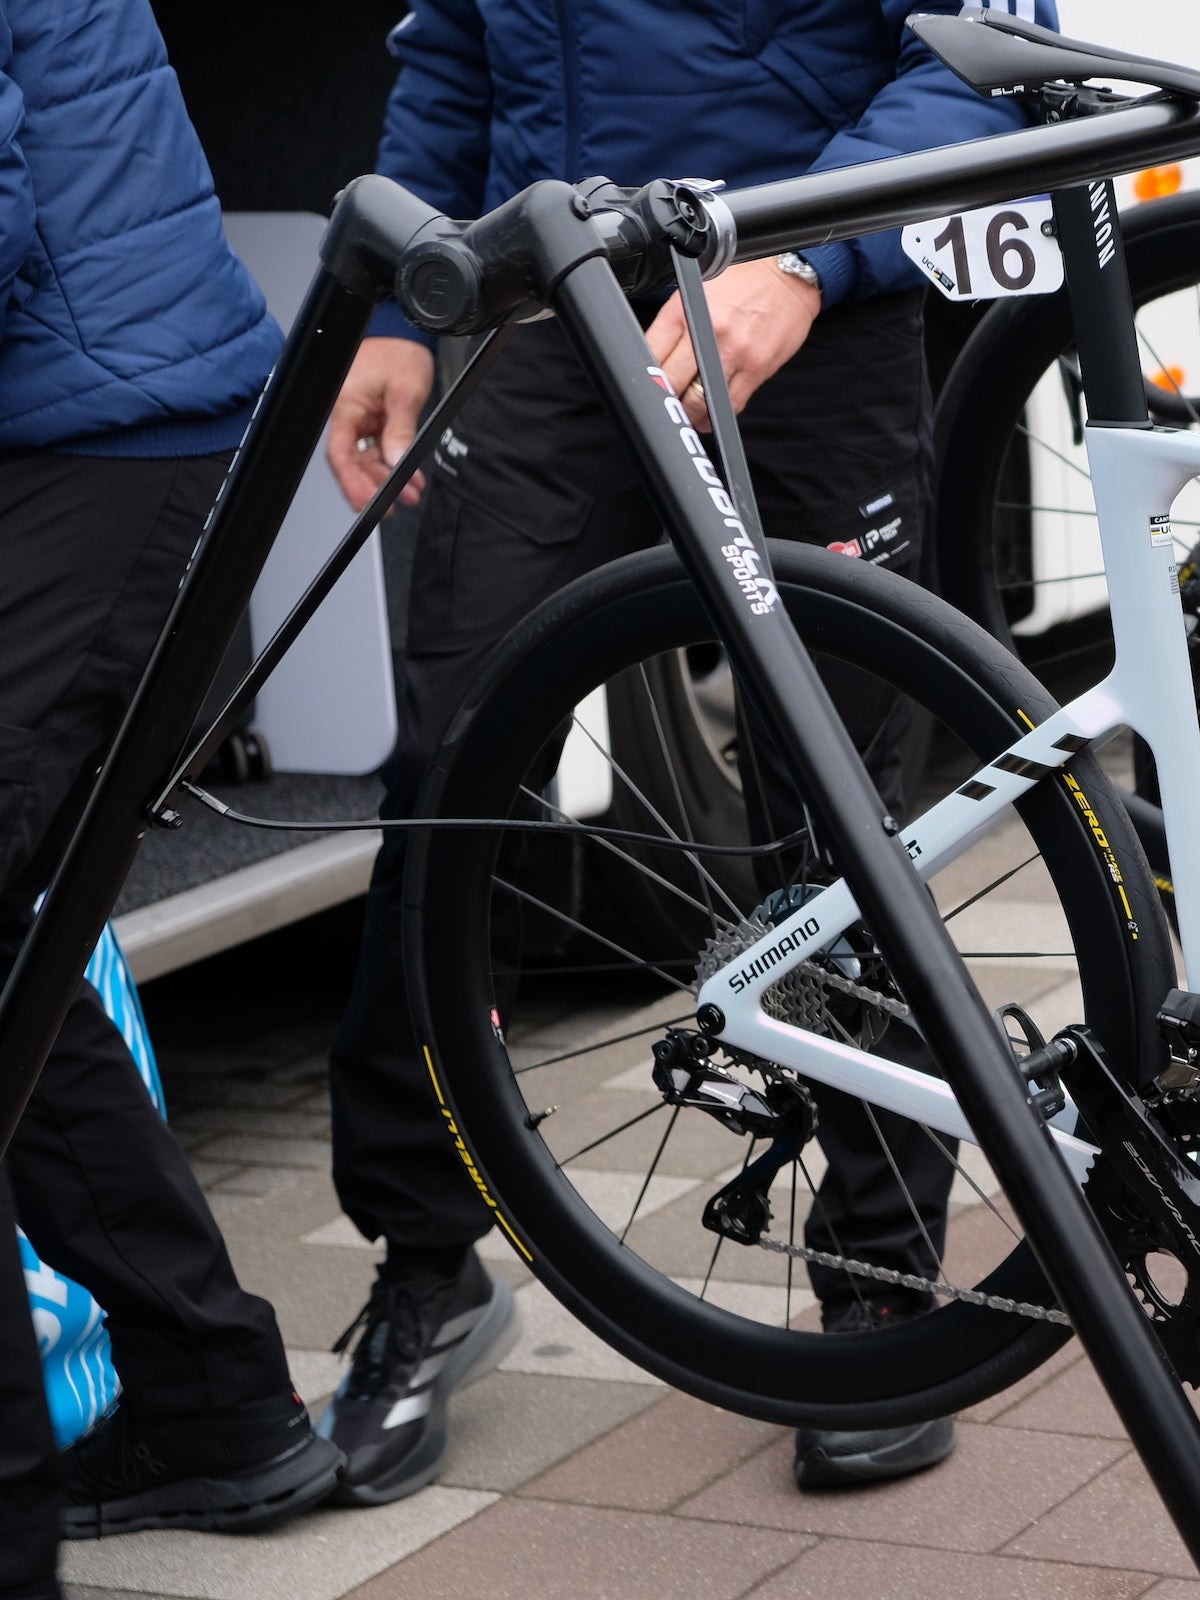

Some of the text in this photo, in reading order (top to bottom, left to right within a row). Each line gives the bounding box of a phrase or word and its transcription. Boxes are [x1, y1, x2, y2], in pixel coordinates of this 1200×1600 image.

[991, 85, 1024, 97] SLR
[933, 210, 1036, 295] 16
[1088, 181, 1115, 269] NYON
[922, 256, 935, 272] UCI
[721, 544, 771, 616] SPORTS
[1063, 772, 1111, 849] ZERO
[728, 917, 820, 994] SHIMANO
[441, 1108, 497, 1207] PIRELLI
